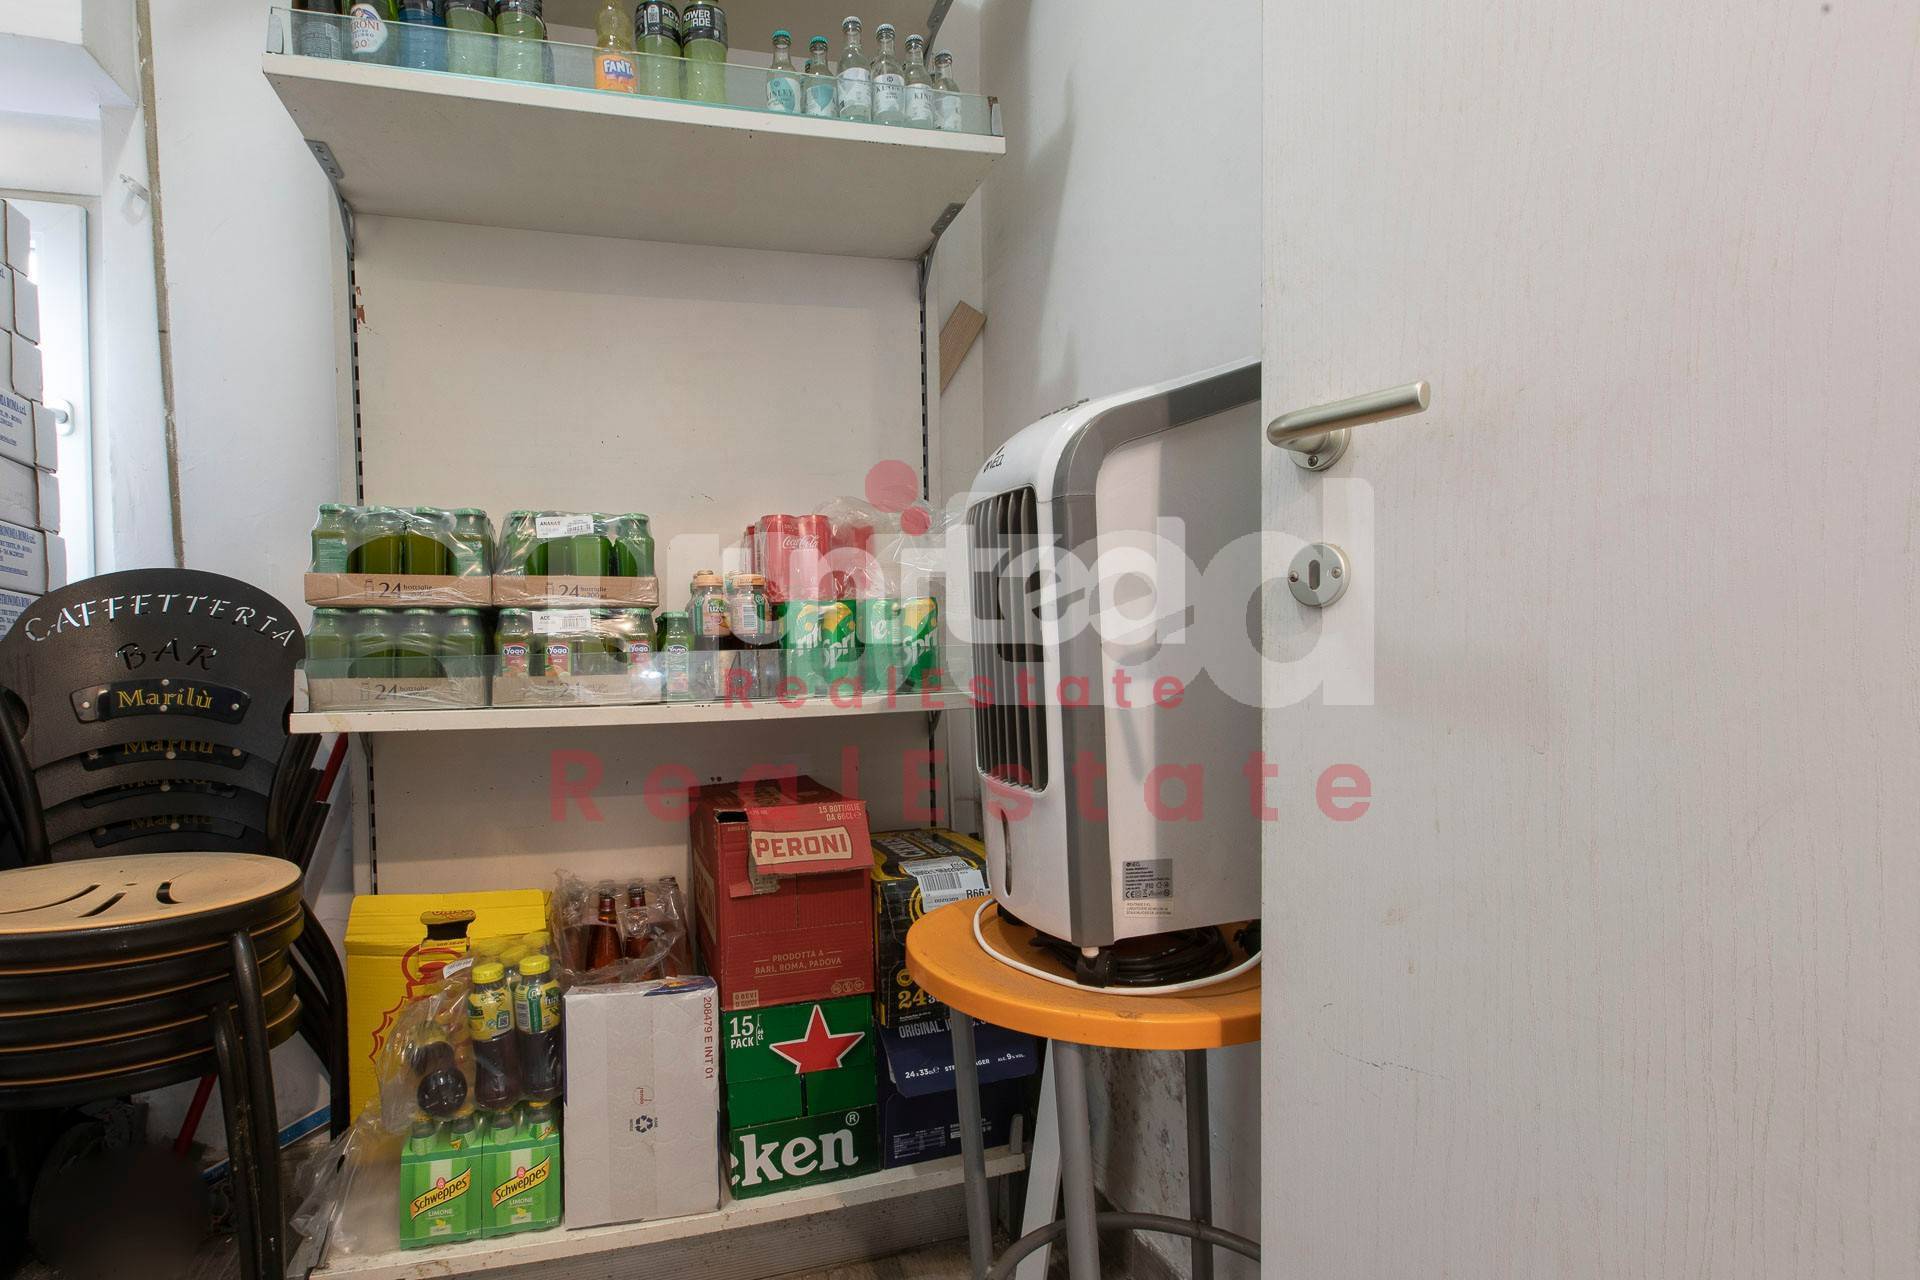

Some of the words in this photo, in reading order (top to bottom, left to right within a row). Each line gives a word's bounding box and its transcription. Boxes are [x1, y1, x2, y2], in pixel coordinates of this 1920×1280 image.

[692, 17, 711, 27] ADE
[379, 582, 401, 598] 24
[559, 584, 579, 597] 24
[25, 593, 296, 647] CAFFETTERIA
[115, 637, 217, 671] BAR
[116, 687, 215, 710] Marilù
[819, 806, 828, 814] 15
[754, 832, 848, 858] PERONI
[772, 950, 817, 962] PRODOTTA
[809, 957, 842, 967] PADOVA
[898, 990, 927, 1009] 24
[703, 997, 712, 1033] 208479
[730, 1015, 755, 1038] 15
[730, 1038, 755, 1049] PACK
[705, 1046, 714, 1064] INT
[495, 1165, 547, 1202] Schweppes
[413, 1175, 468, 1213] Schweppes
[428, 1208, 453, 1217] LIMONE
